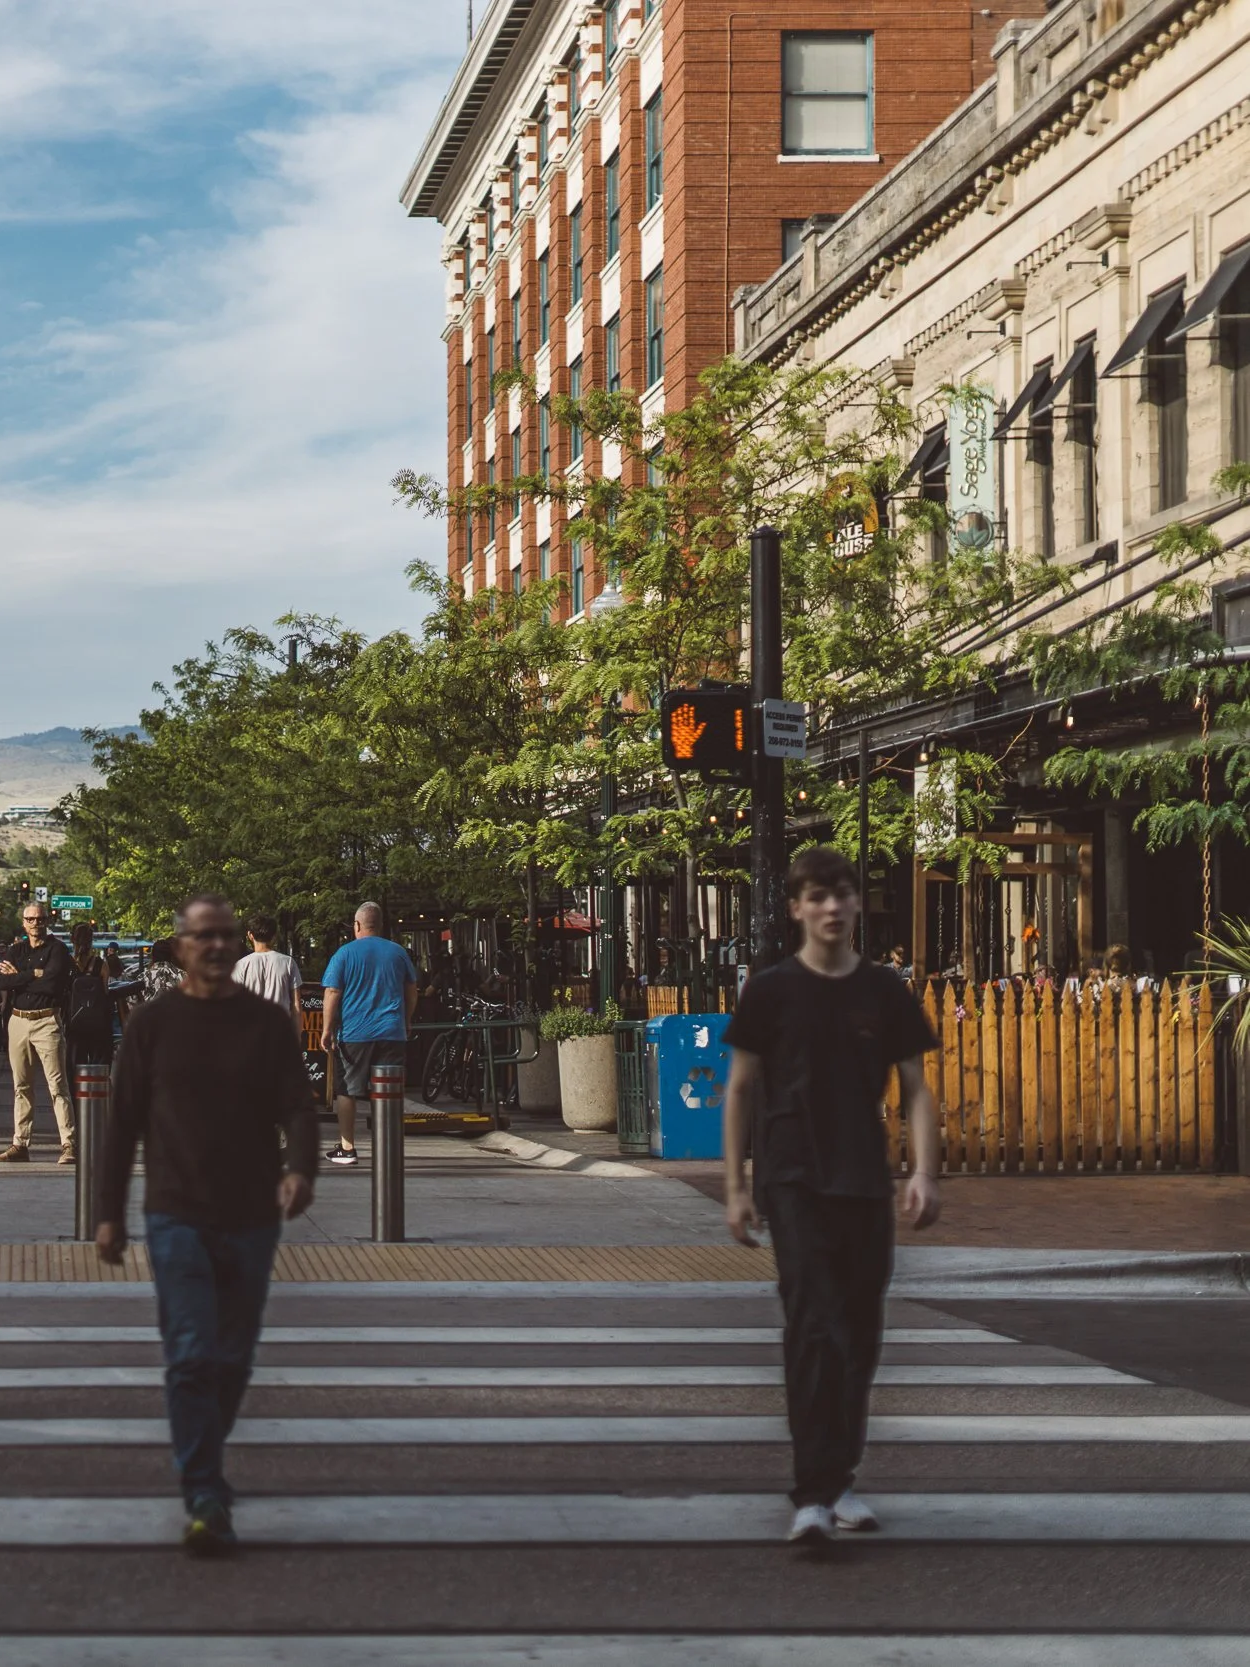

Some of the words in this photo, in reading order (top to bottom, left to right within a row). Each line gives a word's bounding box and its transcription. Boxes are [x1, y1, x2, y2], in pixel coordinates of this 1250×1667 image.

[959, 447, 987, 499] Sage
[837, 523, 863, 543] ALE
[829, 533, 874, 558] OUSE
[766, 711, 786, 720] ACCESS
[58, 900, 86, 908] JEFFERSON
[309, 997, 324, 1006] SON
